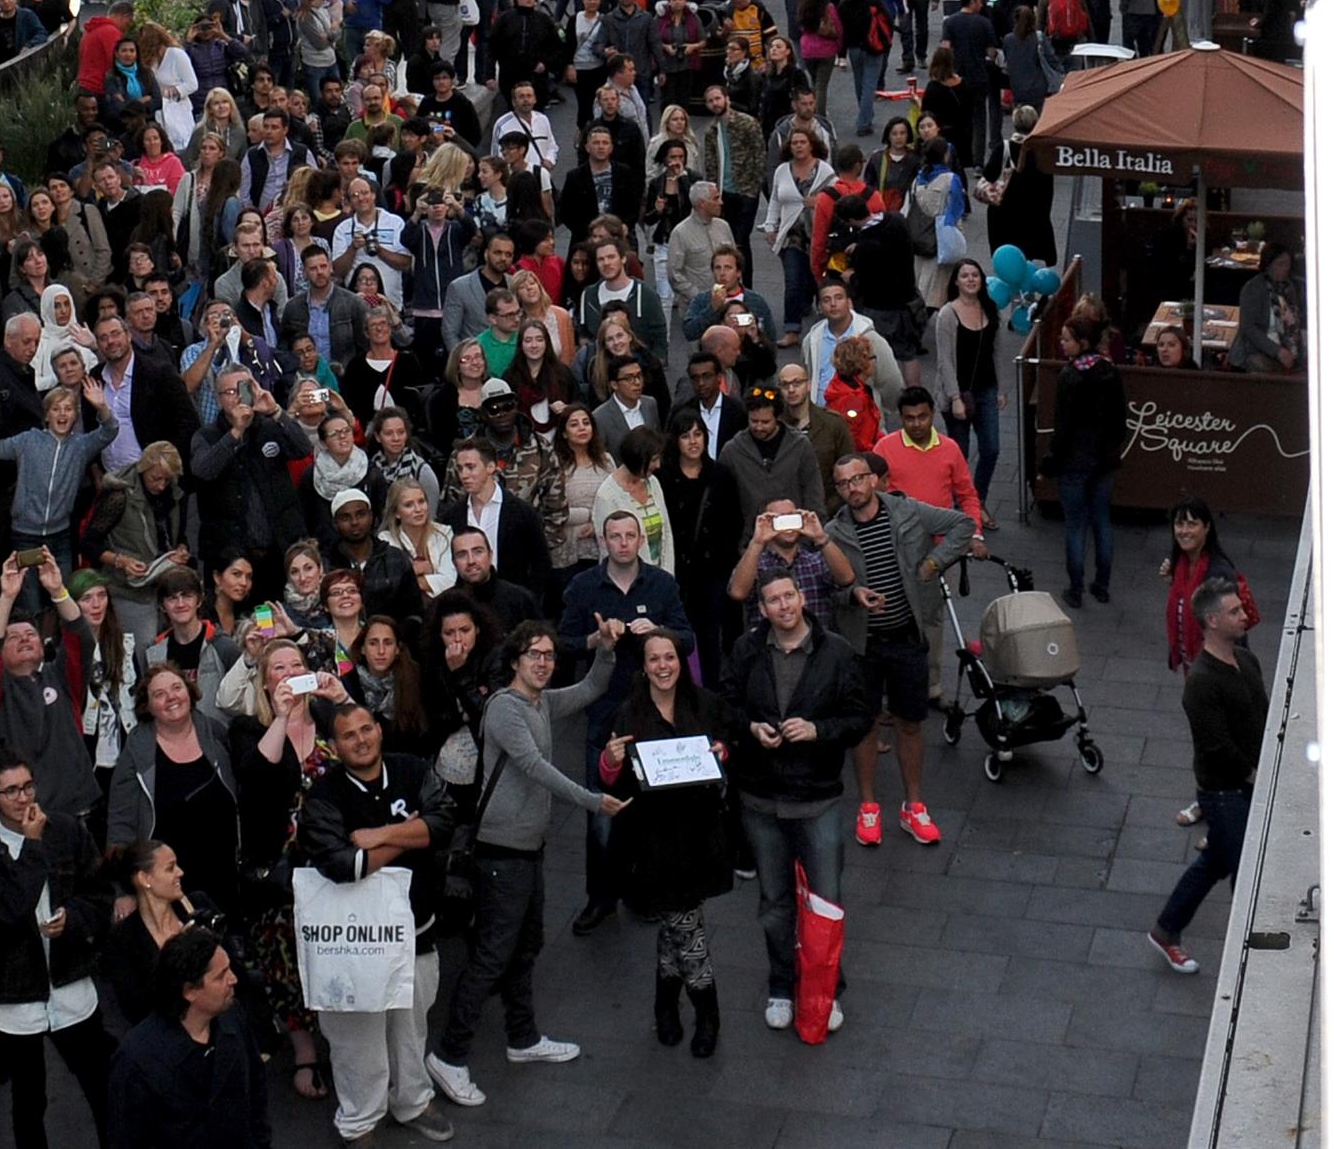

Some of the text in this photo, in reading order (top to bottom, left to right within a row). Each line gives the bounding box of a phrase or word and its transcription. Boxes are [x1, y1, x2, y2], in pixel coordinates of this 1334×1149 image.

[1055, 145, 1174, 175] Bella Italia
[1125, 401, 1236, 437] Leicester
[1140, 426, 1235, 461] Square
[301, 925, 405, 943] SHOP ONLINE
[316, 945, 385, 956] bershka.com
